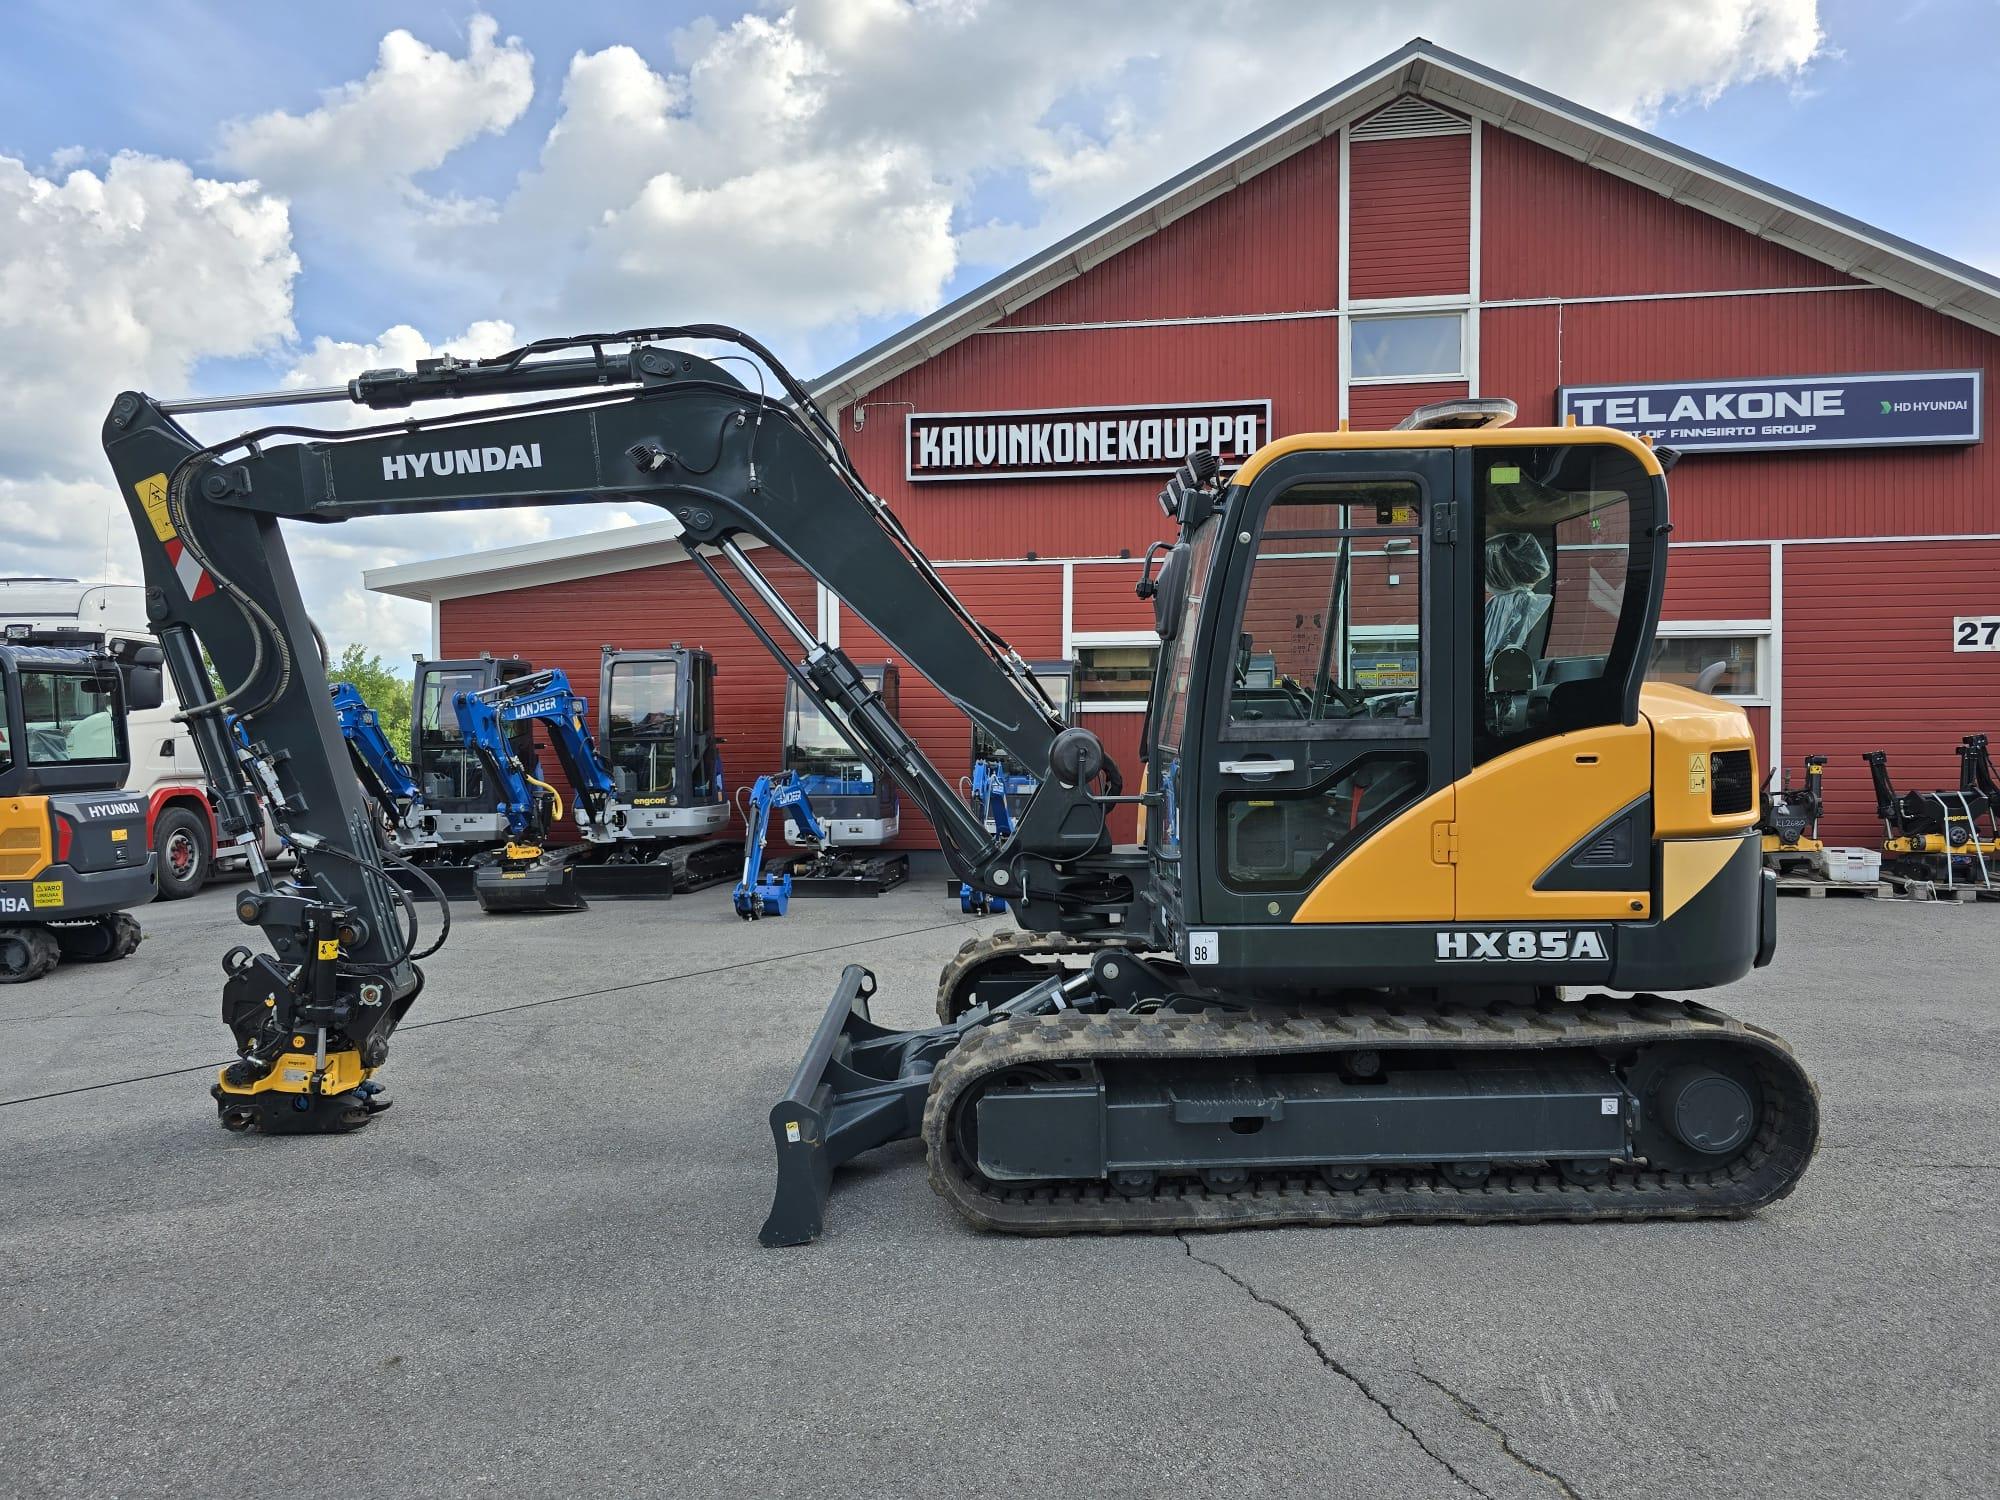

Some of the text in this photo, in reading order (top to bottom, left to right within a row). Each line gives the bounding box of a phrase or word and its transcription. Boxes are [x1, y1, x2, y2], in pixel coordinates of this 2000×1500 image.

[1574, 389, 1845, 425] TELAKONE
[1894, 400, 1968, 412] HD HYUNDAI
[919, 414, 1257, 467] KAIVINKONEKAUPPA
[1646, 429, 1666, 439] OF
[1670, 426, 1756, 438] FINNSIIRTO
[1761, 424, 1817, 435] GROUP
[382, 443, 542, 481] HYUNDAI
[1958, 622, 2000, 645] 27
[515, 697, 556, 719] LANDEER
[88, 802, 140, 818] HYUNDAI
[633, 796, 666, 806] engcon
[0, 897, 30, 912] 19A
[1194, 946, 1208, 961] 98
[1436, 930, 1606, 960] HX85A
